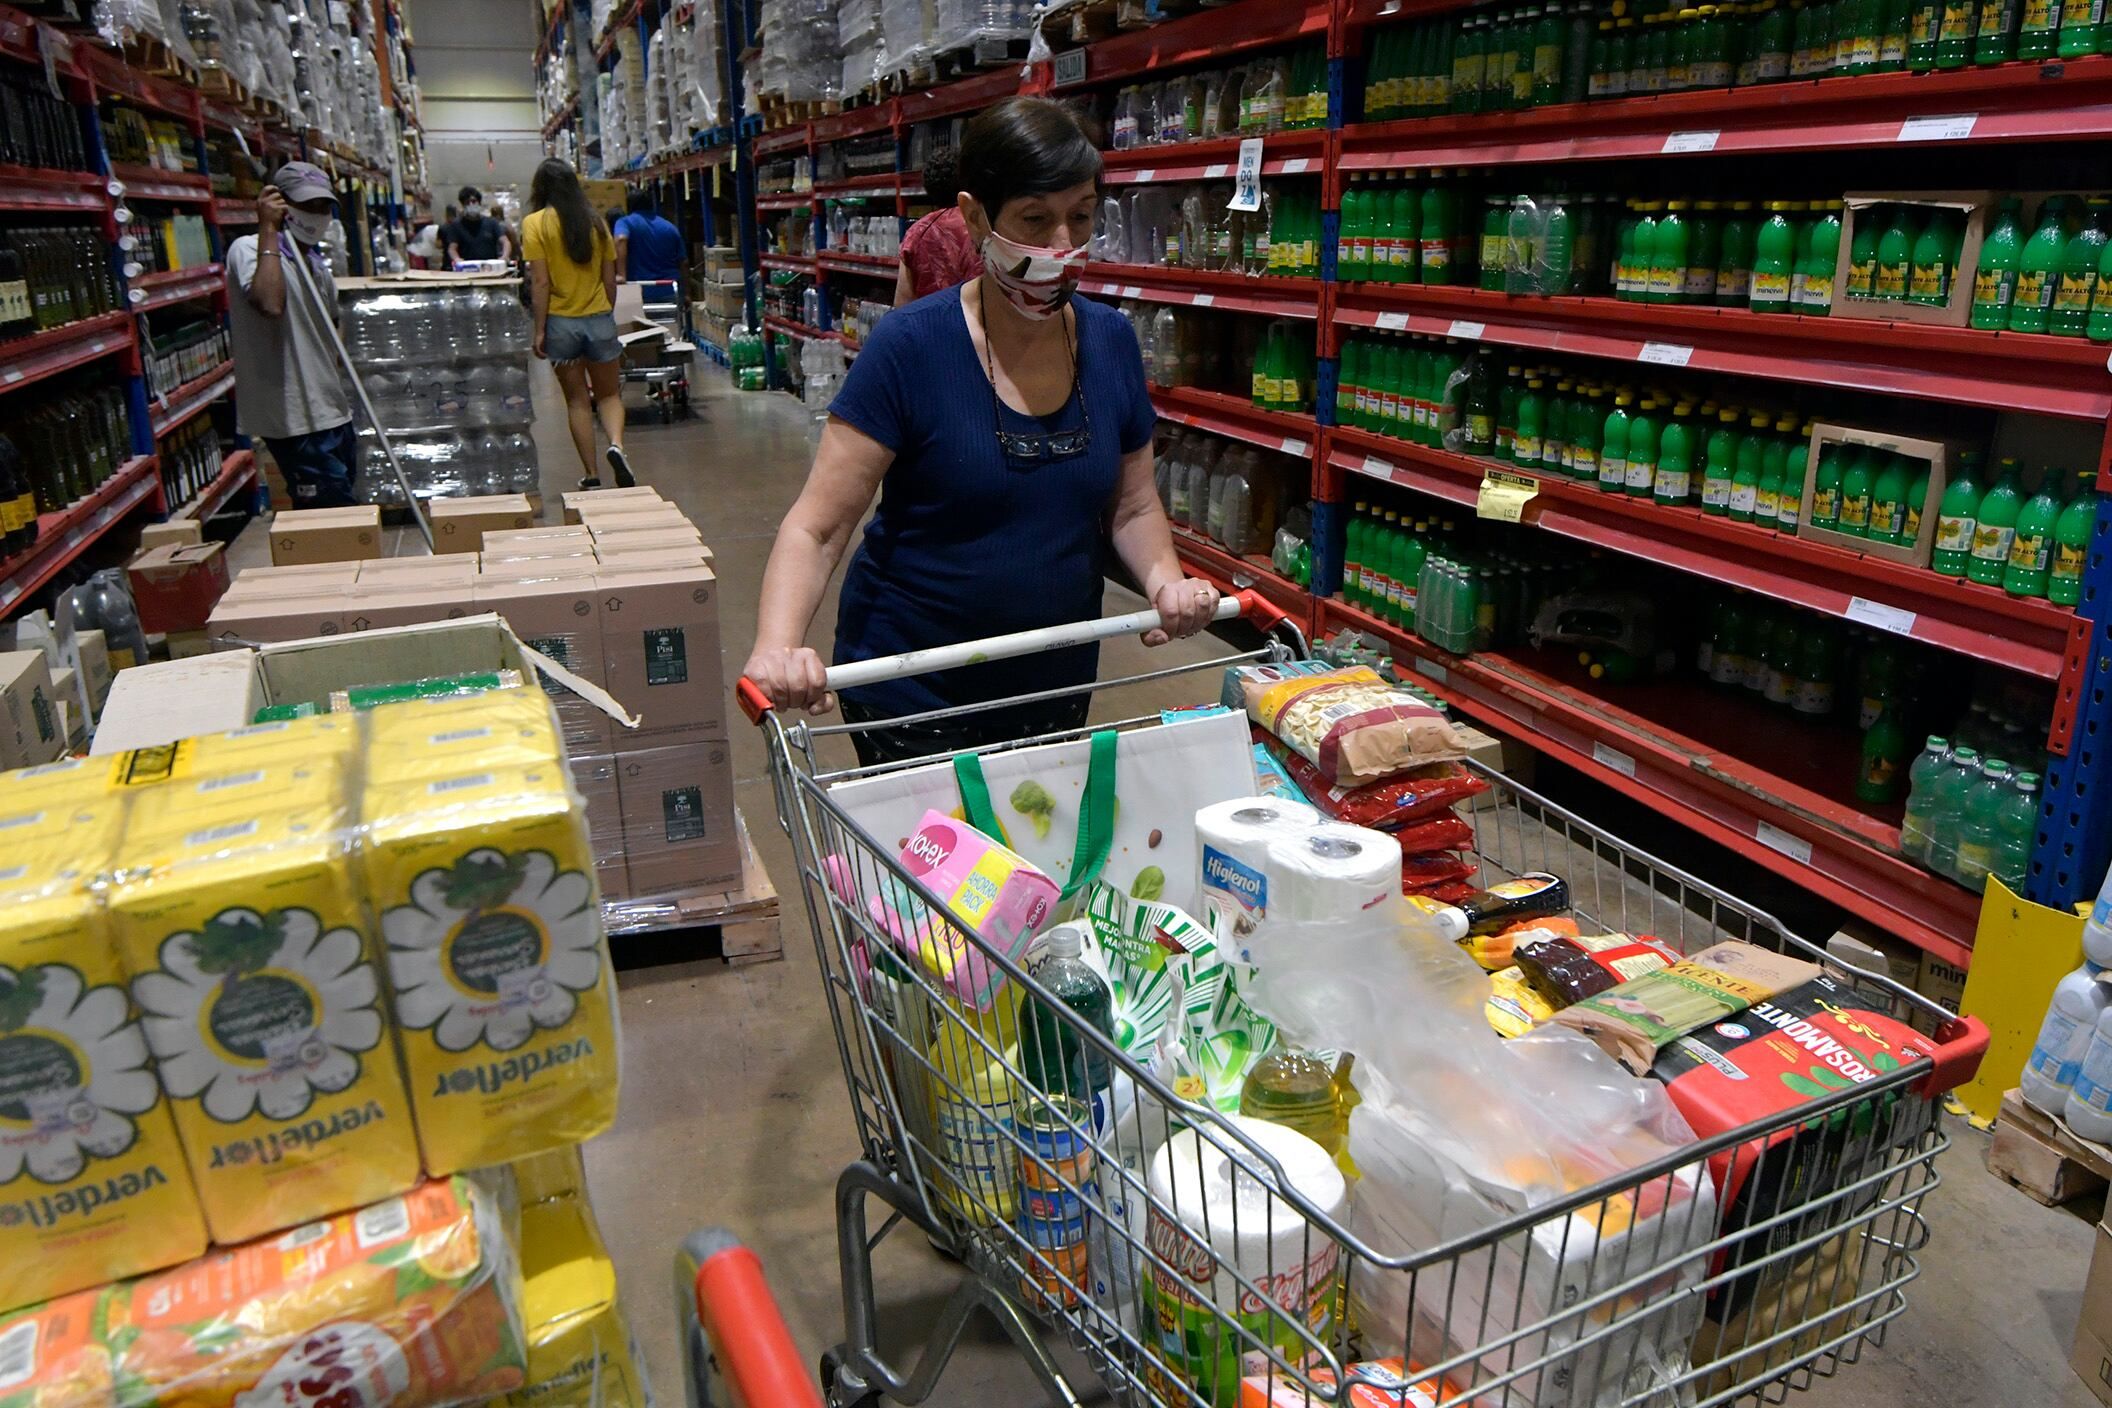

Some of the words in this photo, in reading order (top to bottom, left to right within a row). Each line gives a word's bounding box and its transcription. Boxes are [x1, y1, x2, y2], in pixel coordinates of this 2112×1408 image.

[1058, 55, 1082, 80] SALIDA
[1500, 474, 1521, 483] OFERTA
[966, 871, 999, 901] AHORRA
[1206, 855, 1261, 895] Higienol
[960, 889, 985, 914] PACK
[1094, 918, 1120, 936] MEJO
[1749, 1002, 1877, 1084] ROSAMONTE
[434, 1036, 593, 1097] verdeflor
[1703, 1052, 1733, 1075] PLUS
[210, 1099, 386, 1170] verdeflor
[0, 1162, 168, 1228] verdeflo
